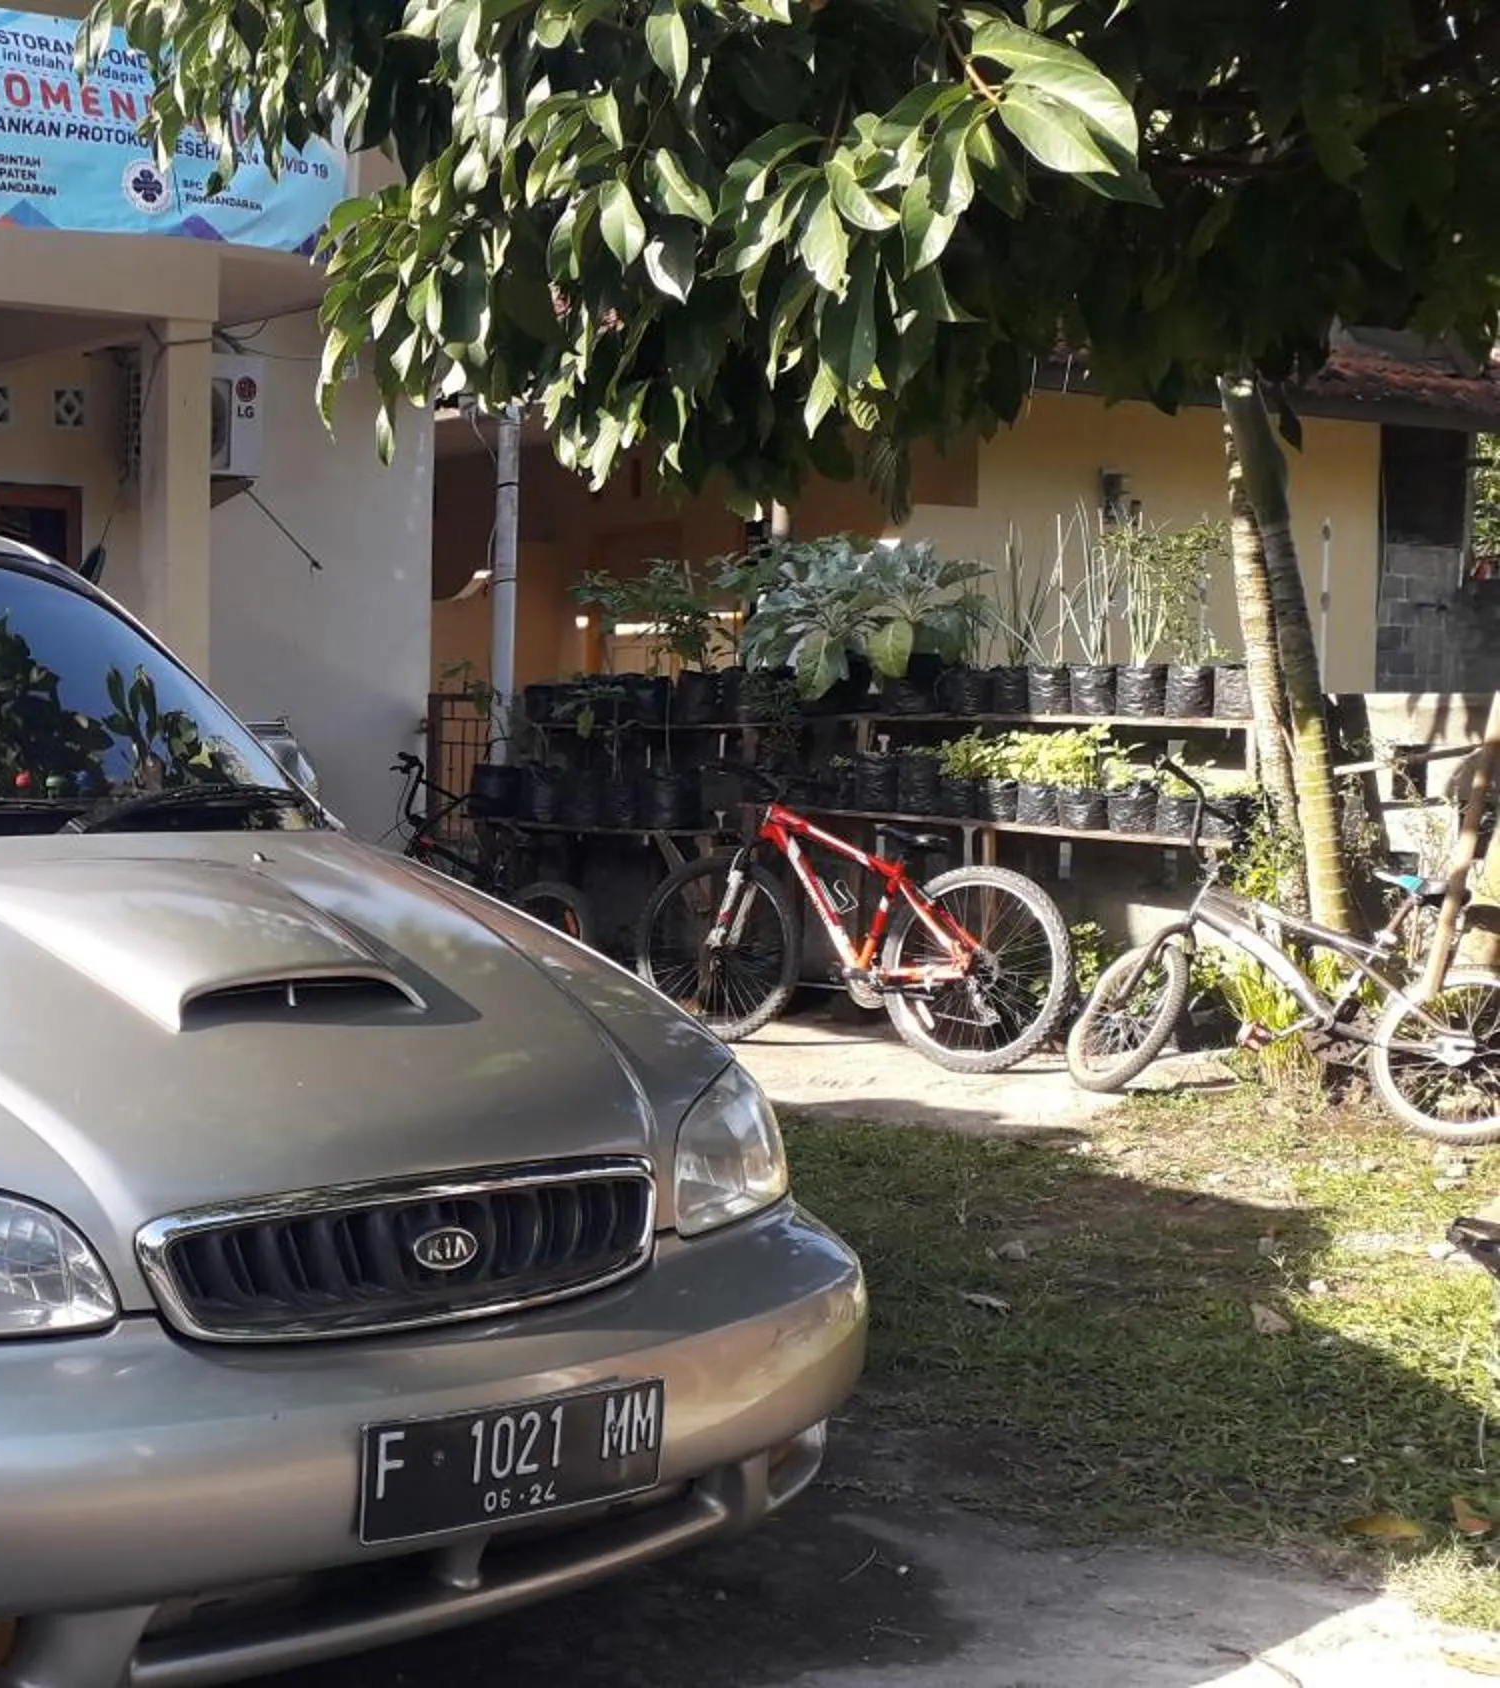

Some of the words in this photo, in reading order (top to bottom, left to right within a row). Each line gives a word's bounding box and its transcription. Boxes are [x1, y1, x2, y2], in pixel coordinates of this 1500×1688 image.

[2, 48, 21, 63] ini
[25, 51, 65, 71] telah
[65, 122, 150, 149] PROTOKO
[311, 162, 329, 180] 19
[236, 405, 255, 419] LG
[427, 1235, 470, 1261] KIA
[375, 1430, 405, 1500] F
[470, 1405, 564, 1485] 1021
[600, 1387, 657, 1461] MM
